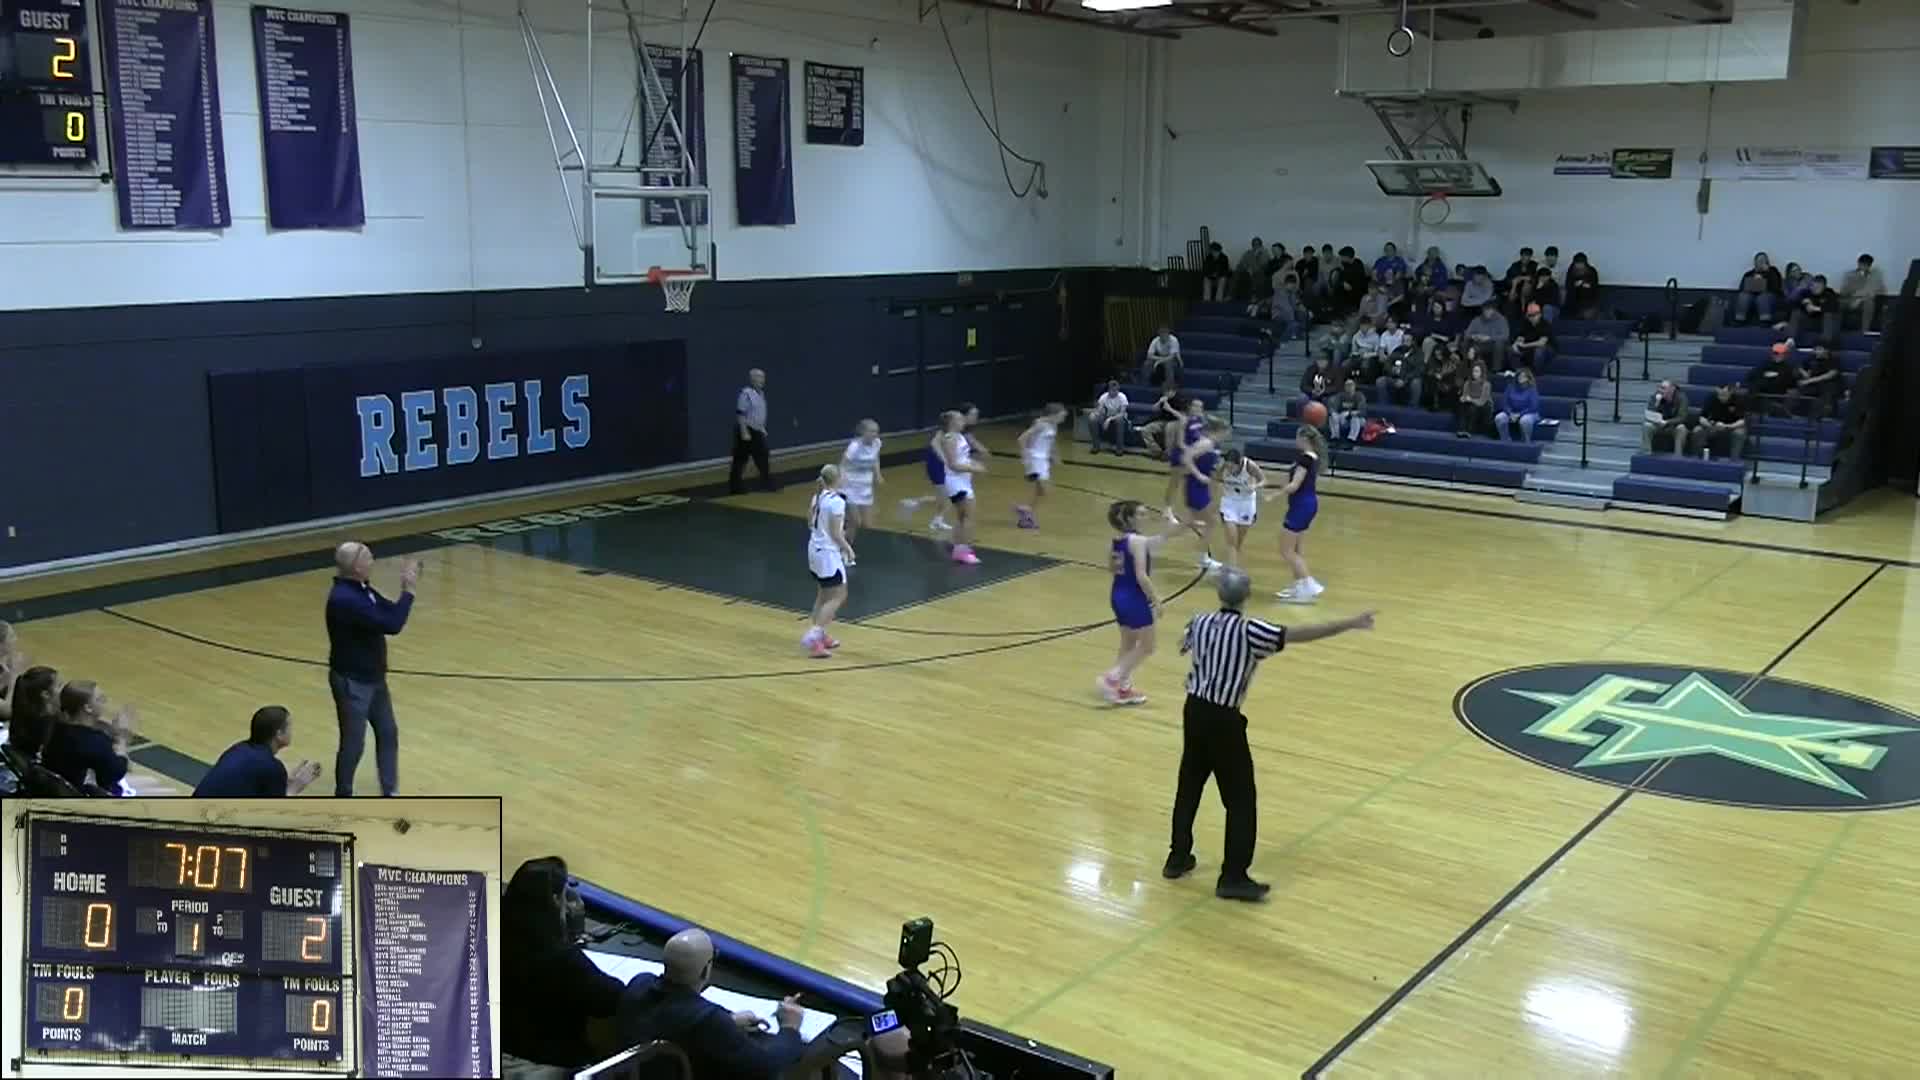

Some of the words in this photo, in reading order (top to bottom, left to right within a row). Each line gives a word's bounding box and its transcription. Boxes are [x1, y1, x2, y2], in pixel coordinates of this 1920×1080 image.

[20, 9, 71, 31] GUEST
[52, 37, 76, 78] 2
[66, 111, 84, 141] 0
[356, 374, 592, 478] REBELS
[431, 493, 692, 543] REBELS
[165, 842, 247, 889] 7:07
[378, 868, 402, 882] MVC
[404, 871, 469, 886] CHAMPIONS
[53, 871, 107, 894] HOME
[171, 899, 209, 914] PERIOD
[269, 885, 323, 908] GUEST
[84, 903, 112, 948] 0
[191, 922, 199, 952] 1
[301, 917, 327, 961] 2
[32, 963, 52, 977] TM
[56, 964, 95, 980] FOULS
[144, 970, 191, 985] PLAYER
[204, 972, 240, 988] FOULS
[283, 976, 300, 991] TM
[304, 978, 340, 993] FOULS
[63, 987, 84, 1020] 0
[312, 1000, 330, 1032] 0
[42, 1027, 82, 1042] POINTS
[171, 1032, 207, 1046] MATCH
[293, 1038, 330, 1051] POINTS
